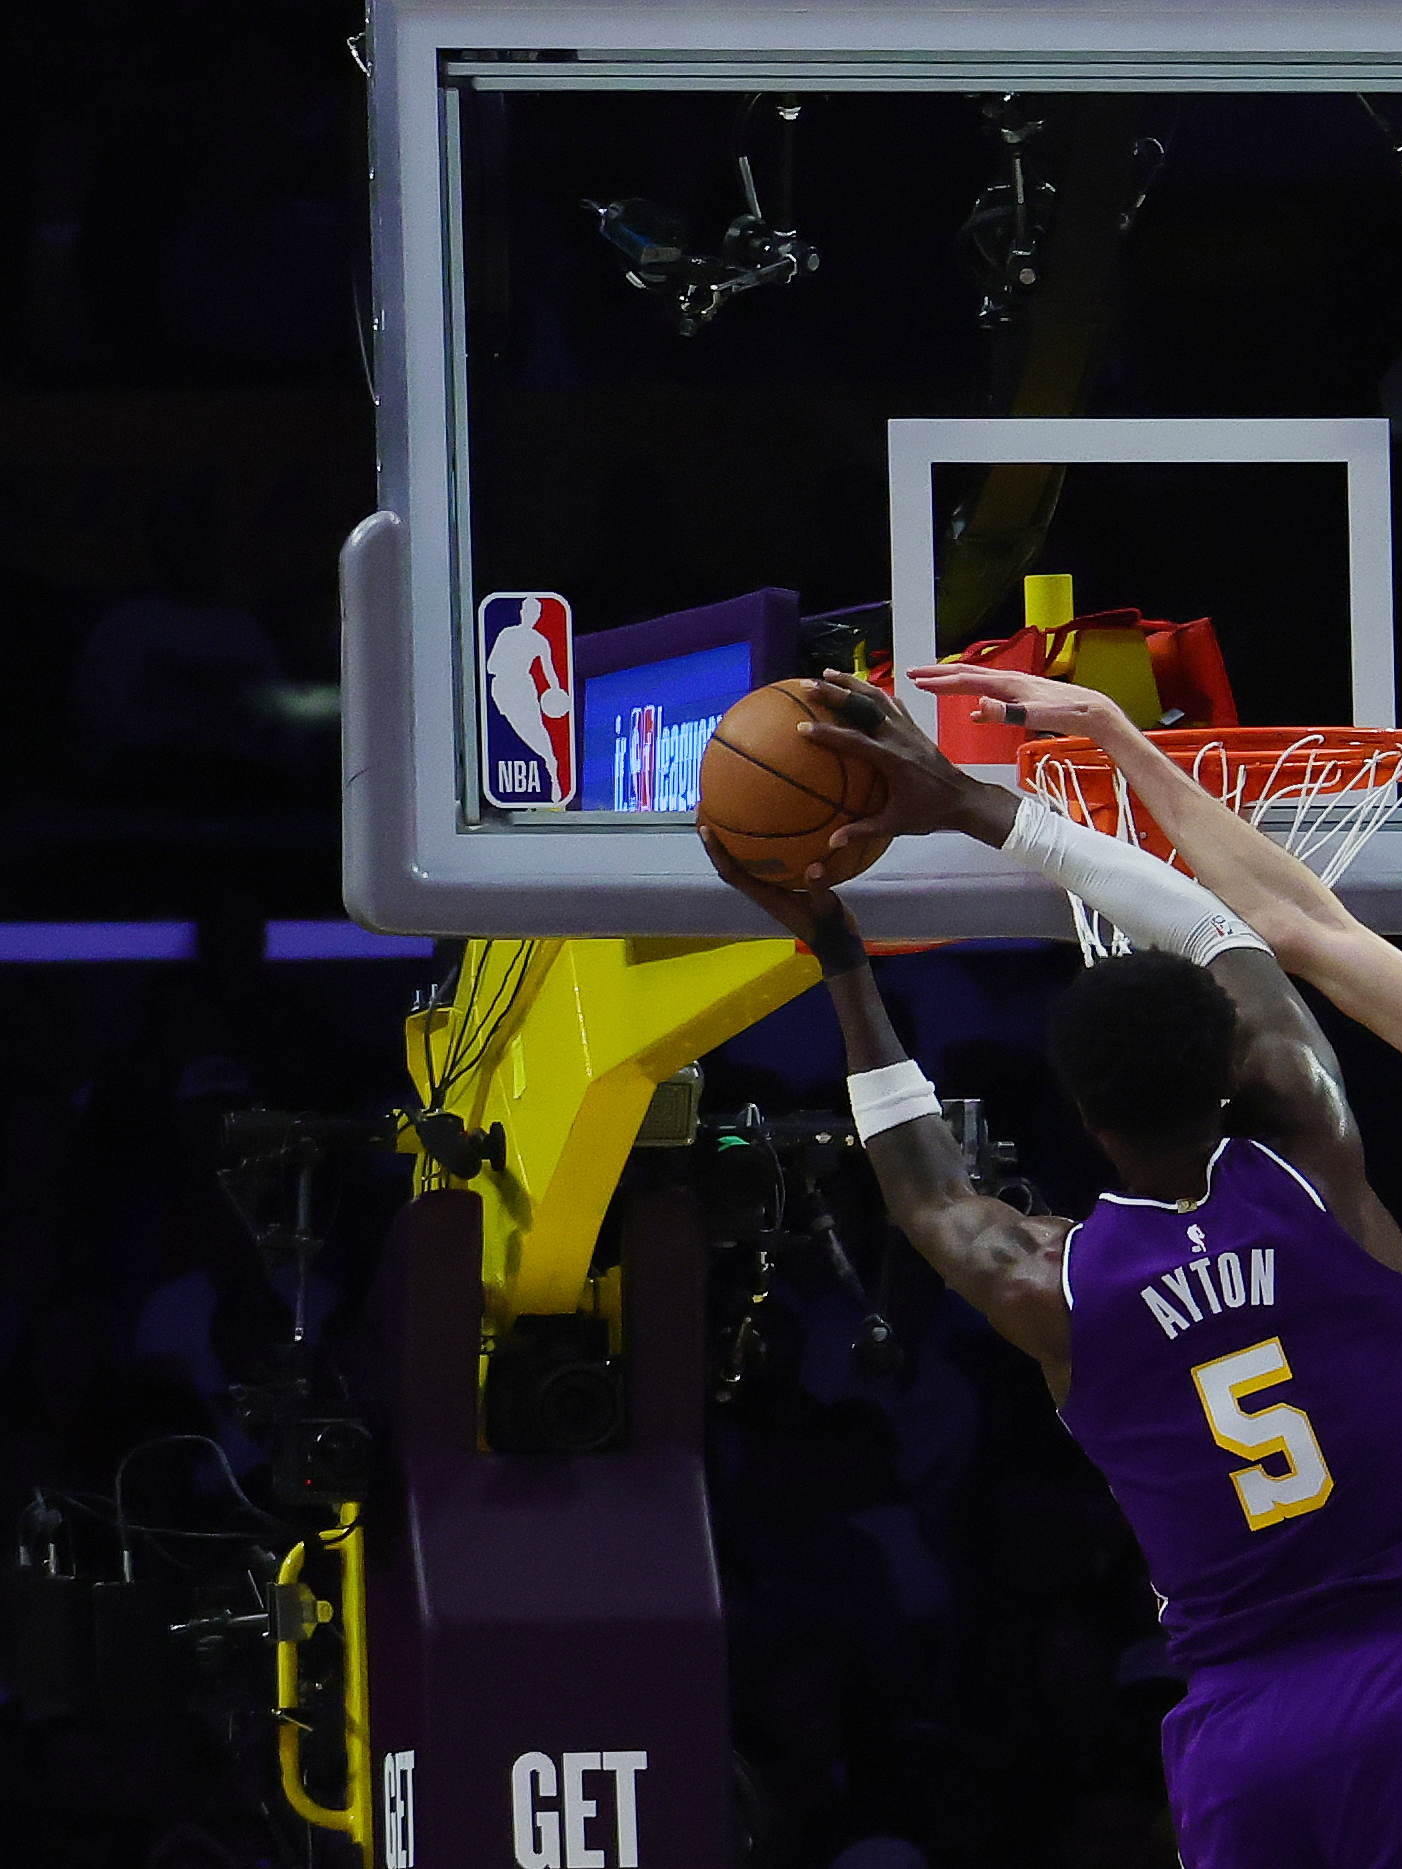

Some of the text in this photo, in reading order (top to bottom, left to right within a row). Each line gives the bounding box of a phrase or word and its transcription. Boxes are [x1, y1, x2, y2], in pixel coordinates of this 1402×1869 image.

[497, 760, 542, 793] NBA
[1140, 1248, 1276, 1340] AYTON
[1190, 1336, 1335, 1532] 5
[384, 1749, 416, 1869] GET
[512, 1750, 648, 1869] GET
